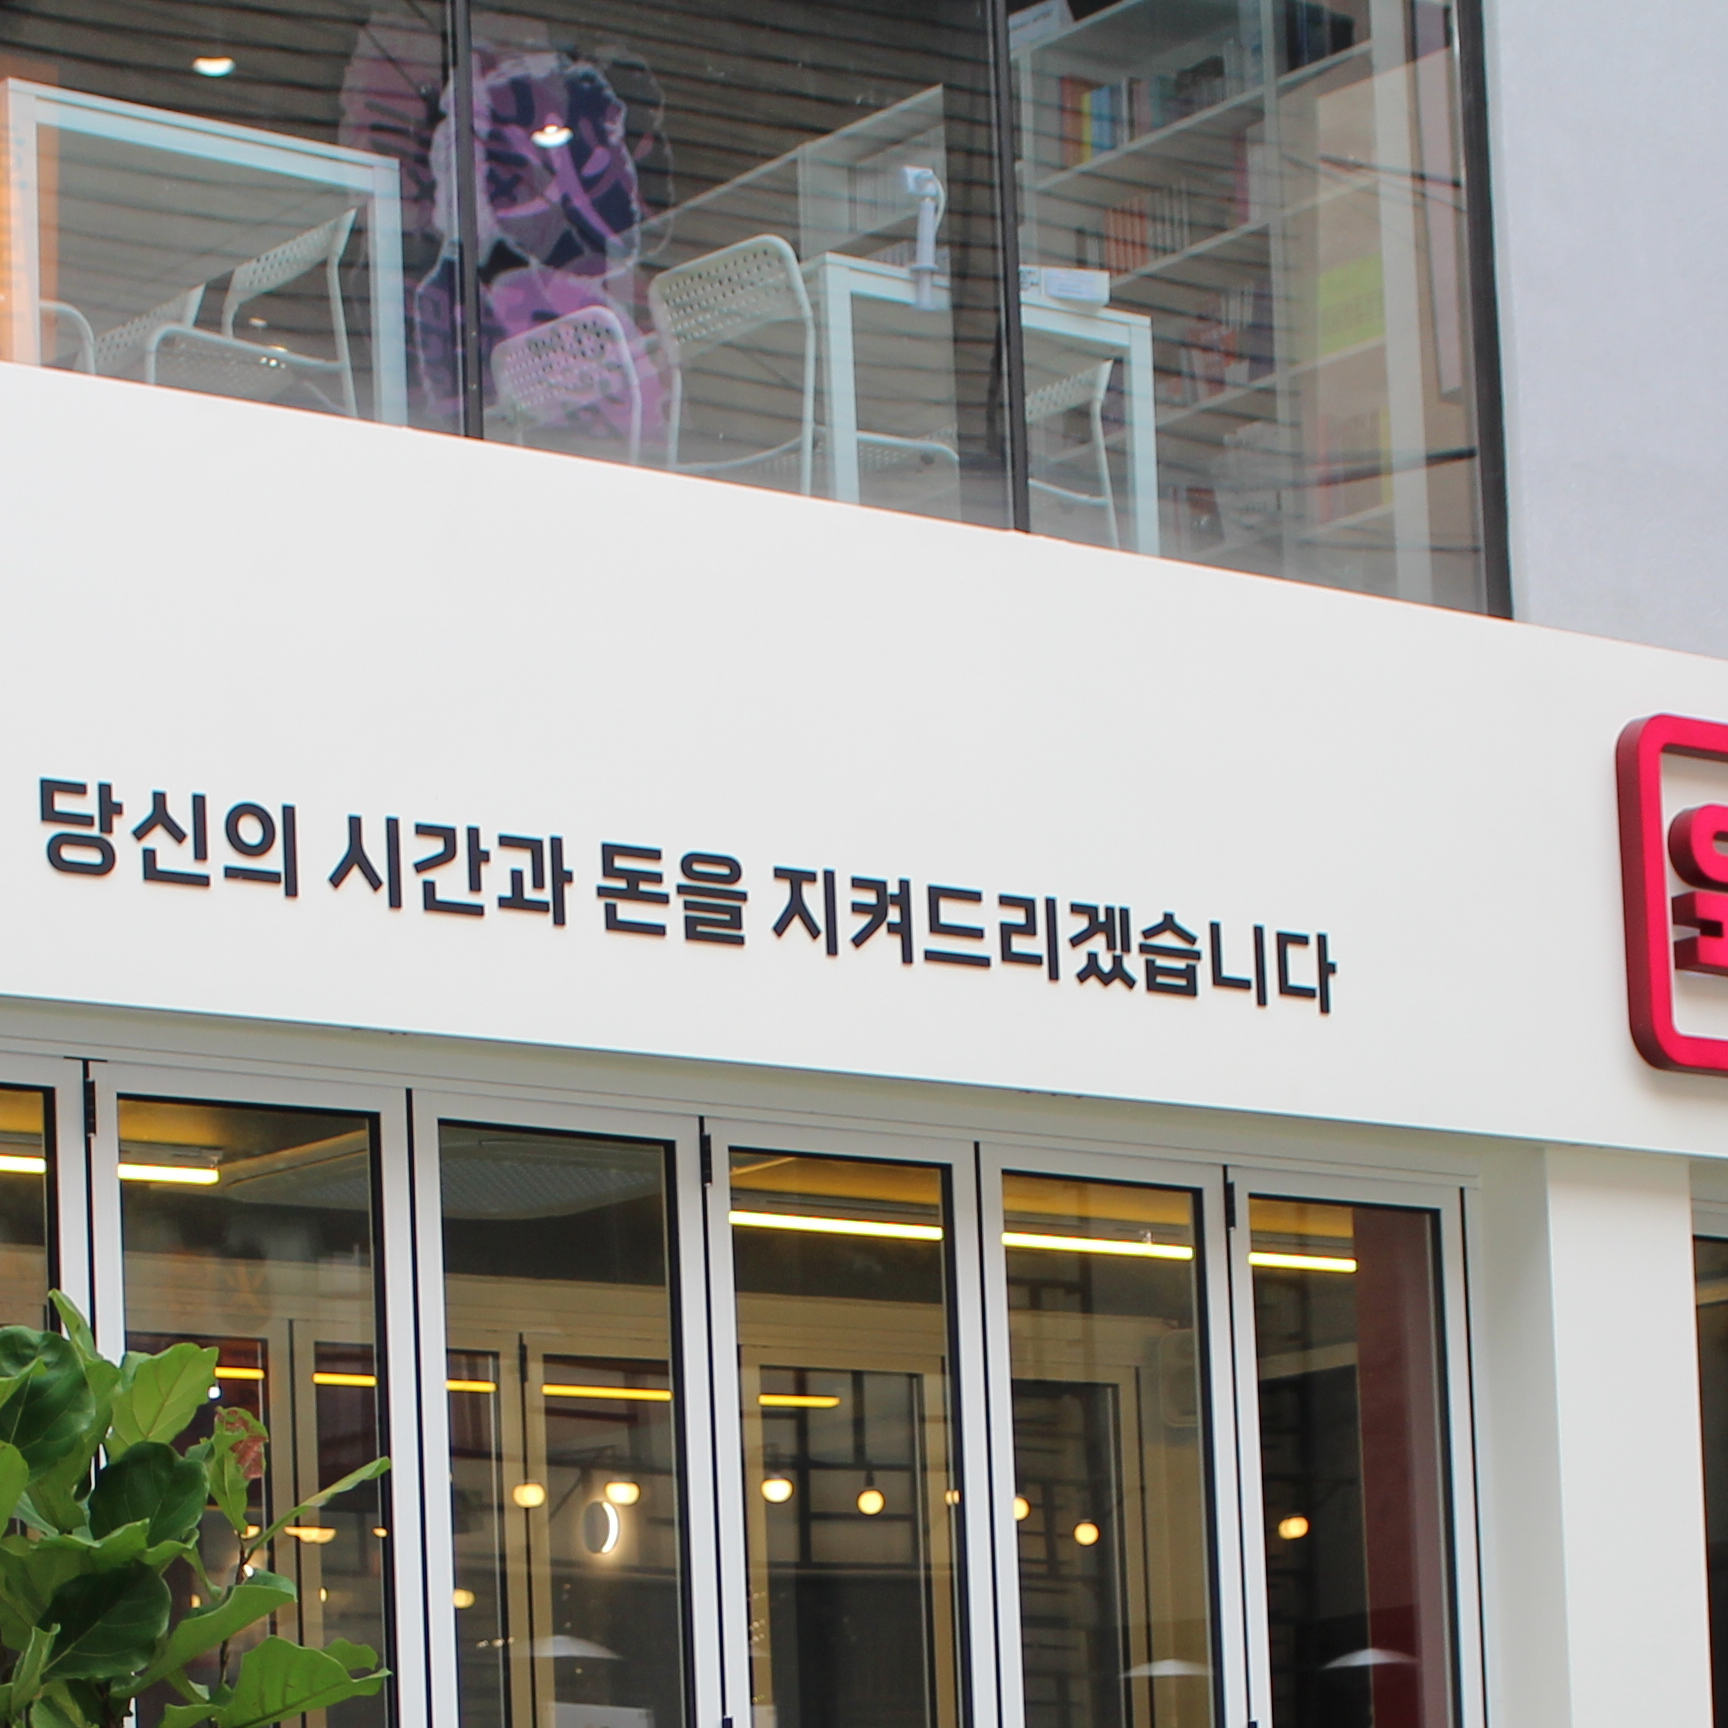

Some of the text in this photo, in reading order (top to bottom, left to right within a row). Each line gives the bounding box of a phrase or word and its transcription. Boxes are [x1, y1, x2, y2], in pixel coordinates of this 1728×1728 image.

[39, 776, 1337, 1016] 당신의 시간과 돈을 지켜드리겠습니다
